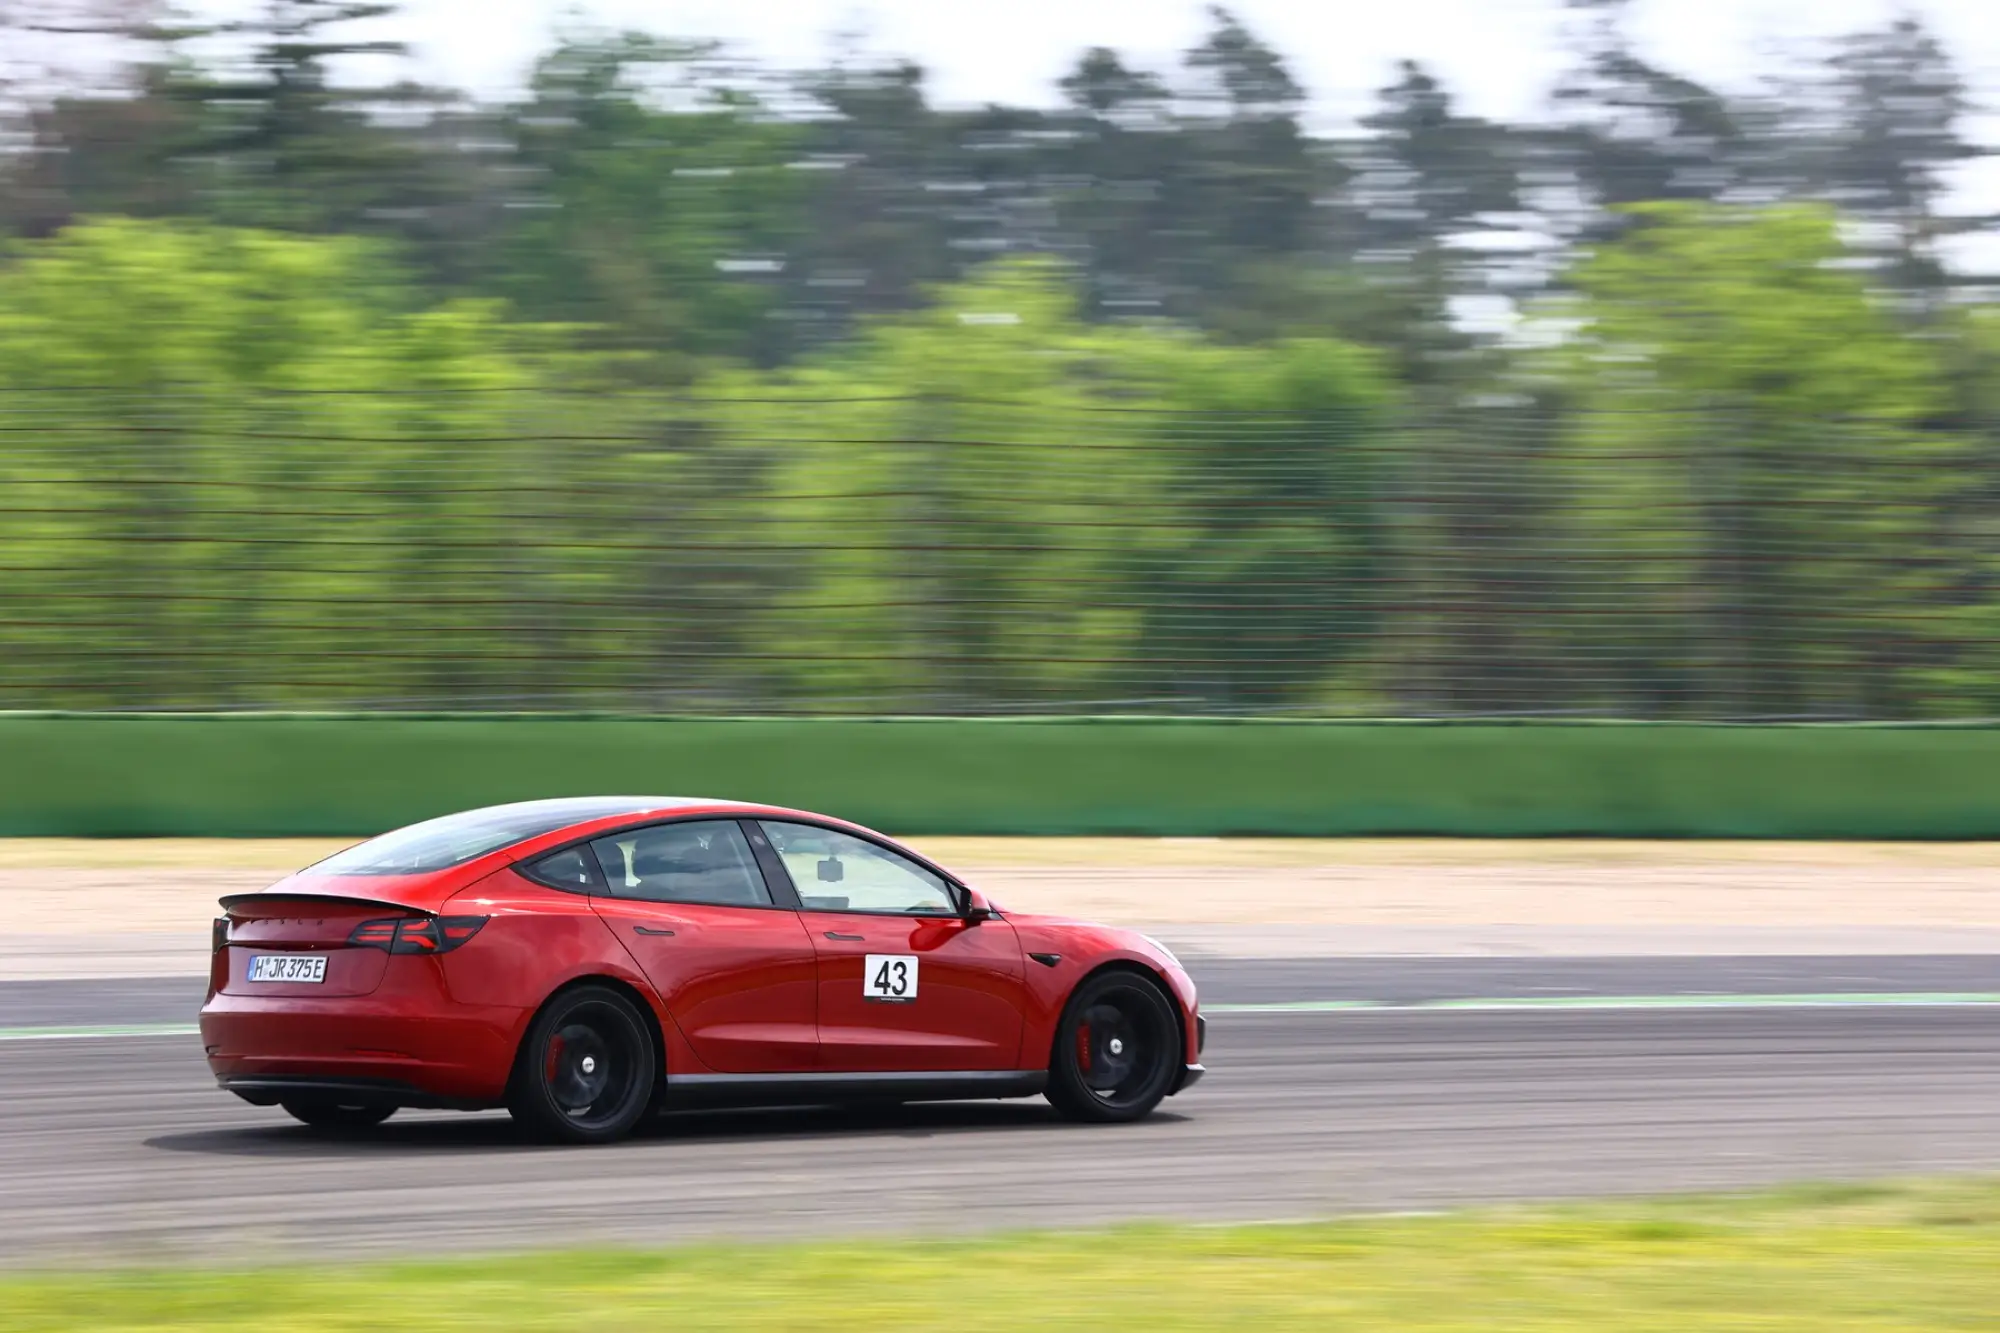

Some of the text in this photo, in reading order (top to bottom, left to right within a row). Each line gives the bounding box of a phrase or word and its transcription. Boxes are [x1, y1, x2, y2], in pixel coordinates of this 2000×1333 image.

[254, 959, 264, 978] H
[269, 959, 287, 978] JR
[874, 961, 907, 995] 43
